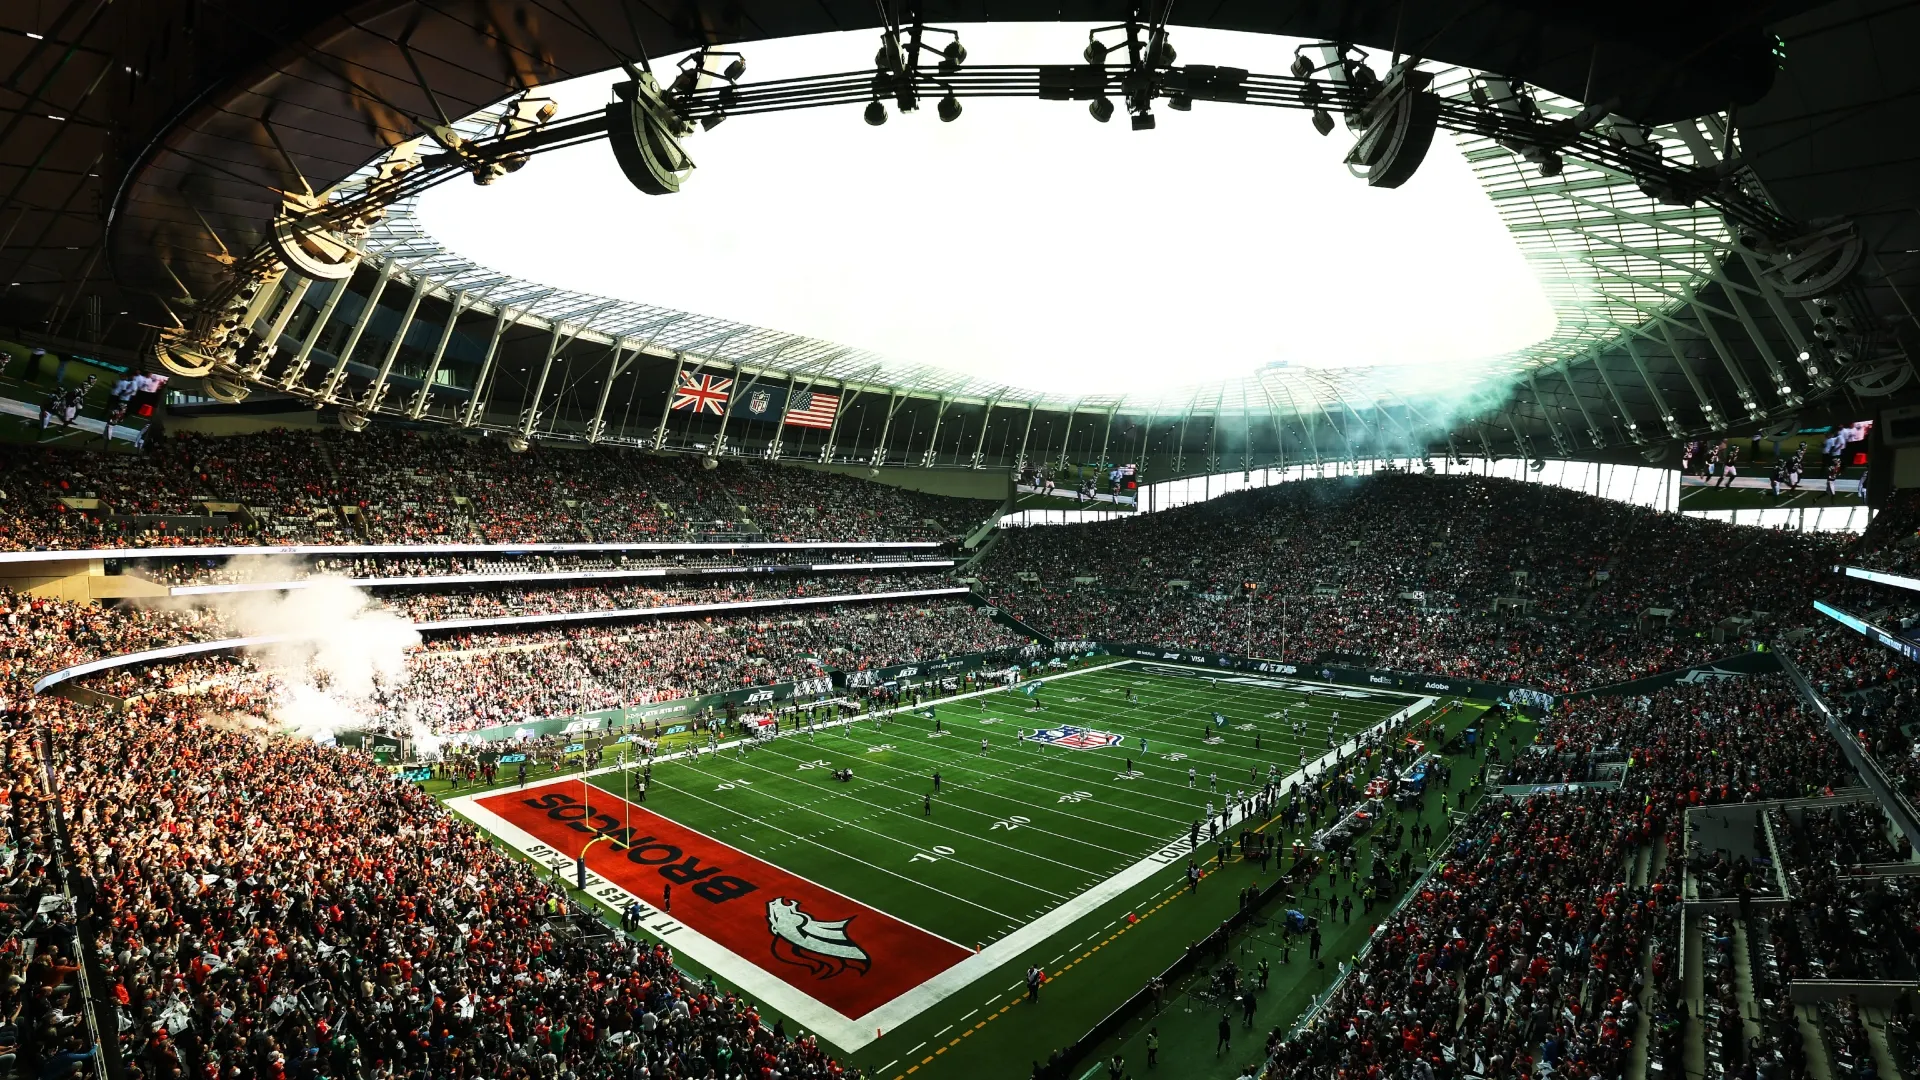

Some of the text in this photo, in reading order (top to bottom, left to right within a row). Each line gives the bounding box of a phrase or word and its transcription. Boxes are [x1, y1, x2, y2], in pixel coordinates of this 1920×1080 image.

[752, 400, 765, 411] NFL
[1190, 655, 1205, 663] VISA
[896, 666, 918, 678] JETS
[1425, 681, 1449, 691] Adobe
[743, 689, 774, 705] JETS
[717, 778, 753, 790] 10
[1060, 790, 1093, 803] 30
[993, 815, 1031, 831] 20
[523, 793, 760, 904] BRONCOS
[526, 845, 554, 858] US
[914, 845, 955, 863] 10
[651, 920, 684, 935] IT
